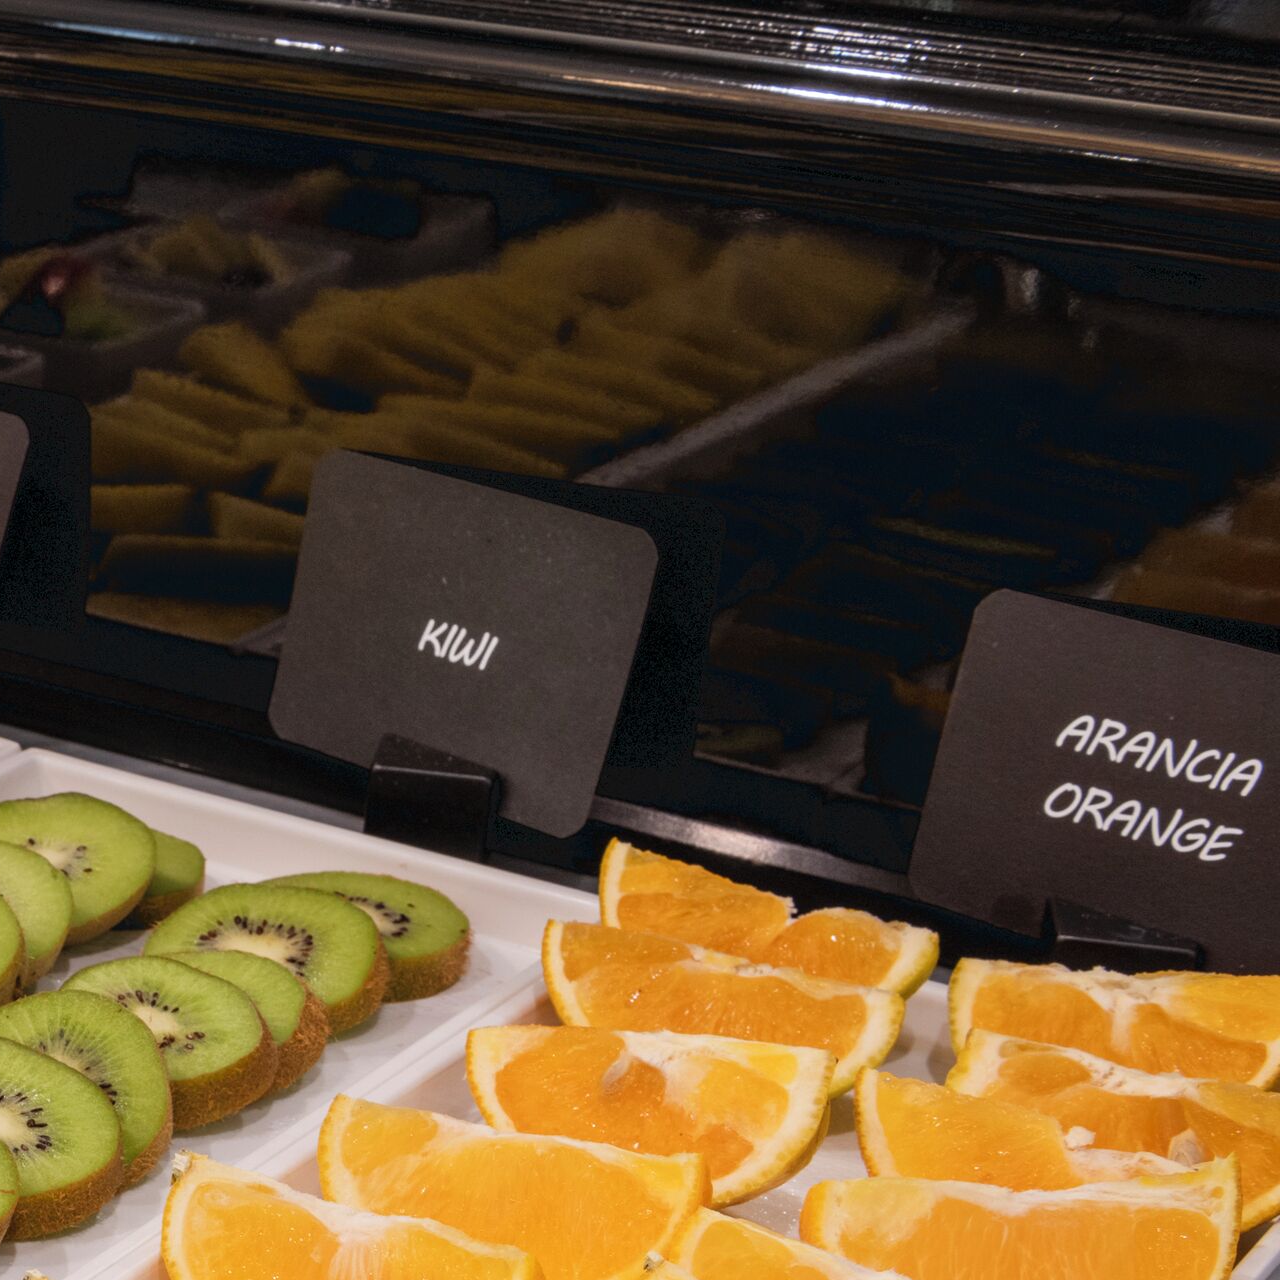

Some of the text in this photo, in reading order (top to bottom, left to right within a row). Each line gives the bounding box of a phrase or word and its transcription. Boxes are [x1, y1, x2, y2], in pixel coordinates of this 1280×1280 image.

[417, 618, 499, 671] KIWI
[1055, 714, 1263, 797] ARANCIA
[1042, 782, 1244, 862] ORANGE
